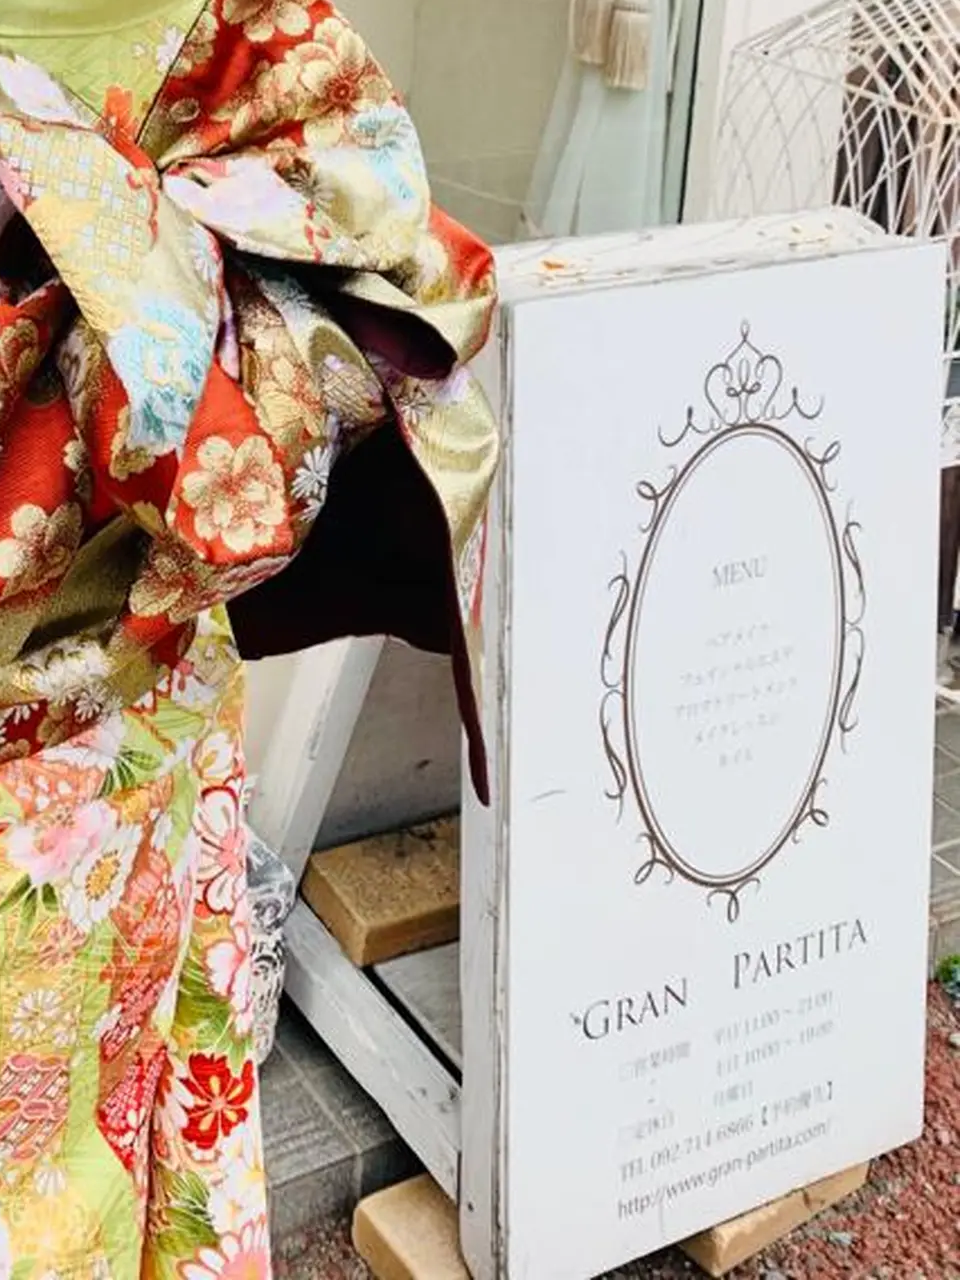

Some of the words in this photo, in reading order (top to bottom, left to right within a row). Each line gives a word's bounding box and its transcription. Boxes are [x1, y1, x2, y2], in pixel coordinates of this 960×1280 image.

[710, 556, 769, 589] MENU
[581, 977, 689, 1041] GRAN
[732, 918, 868, 990] PARTITA
